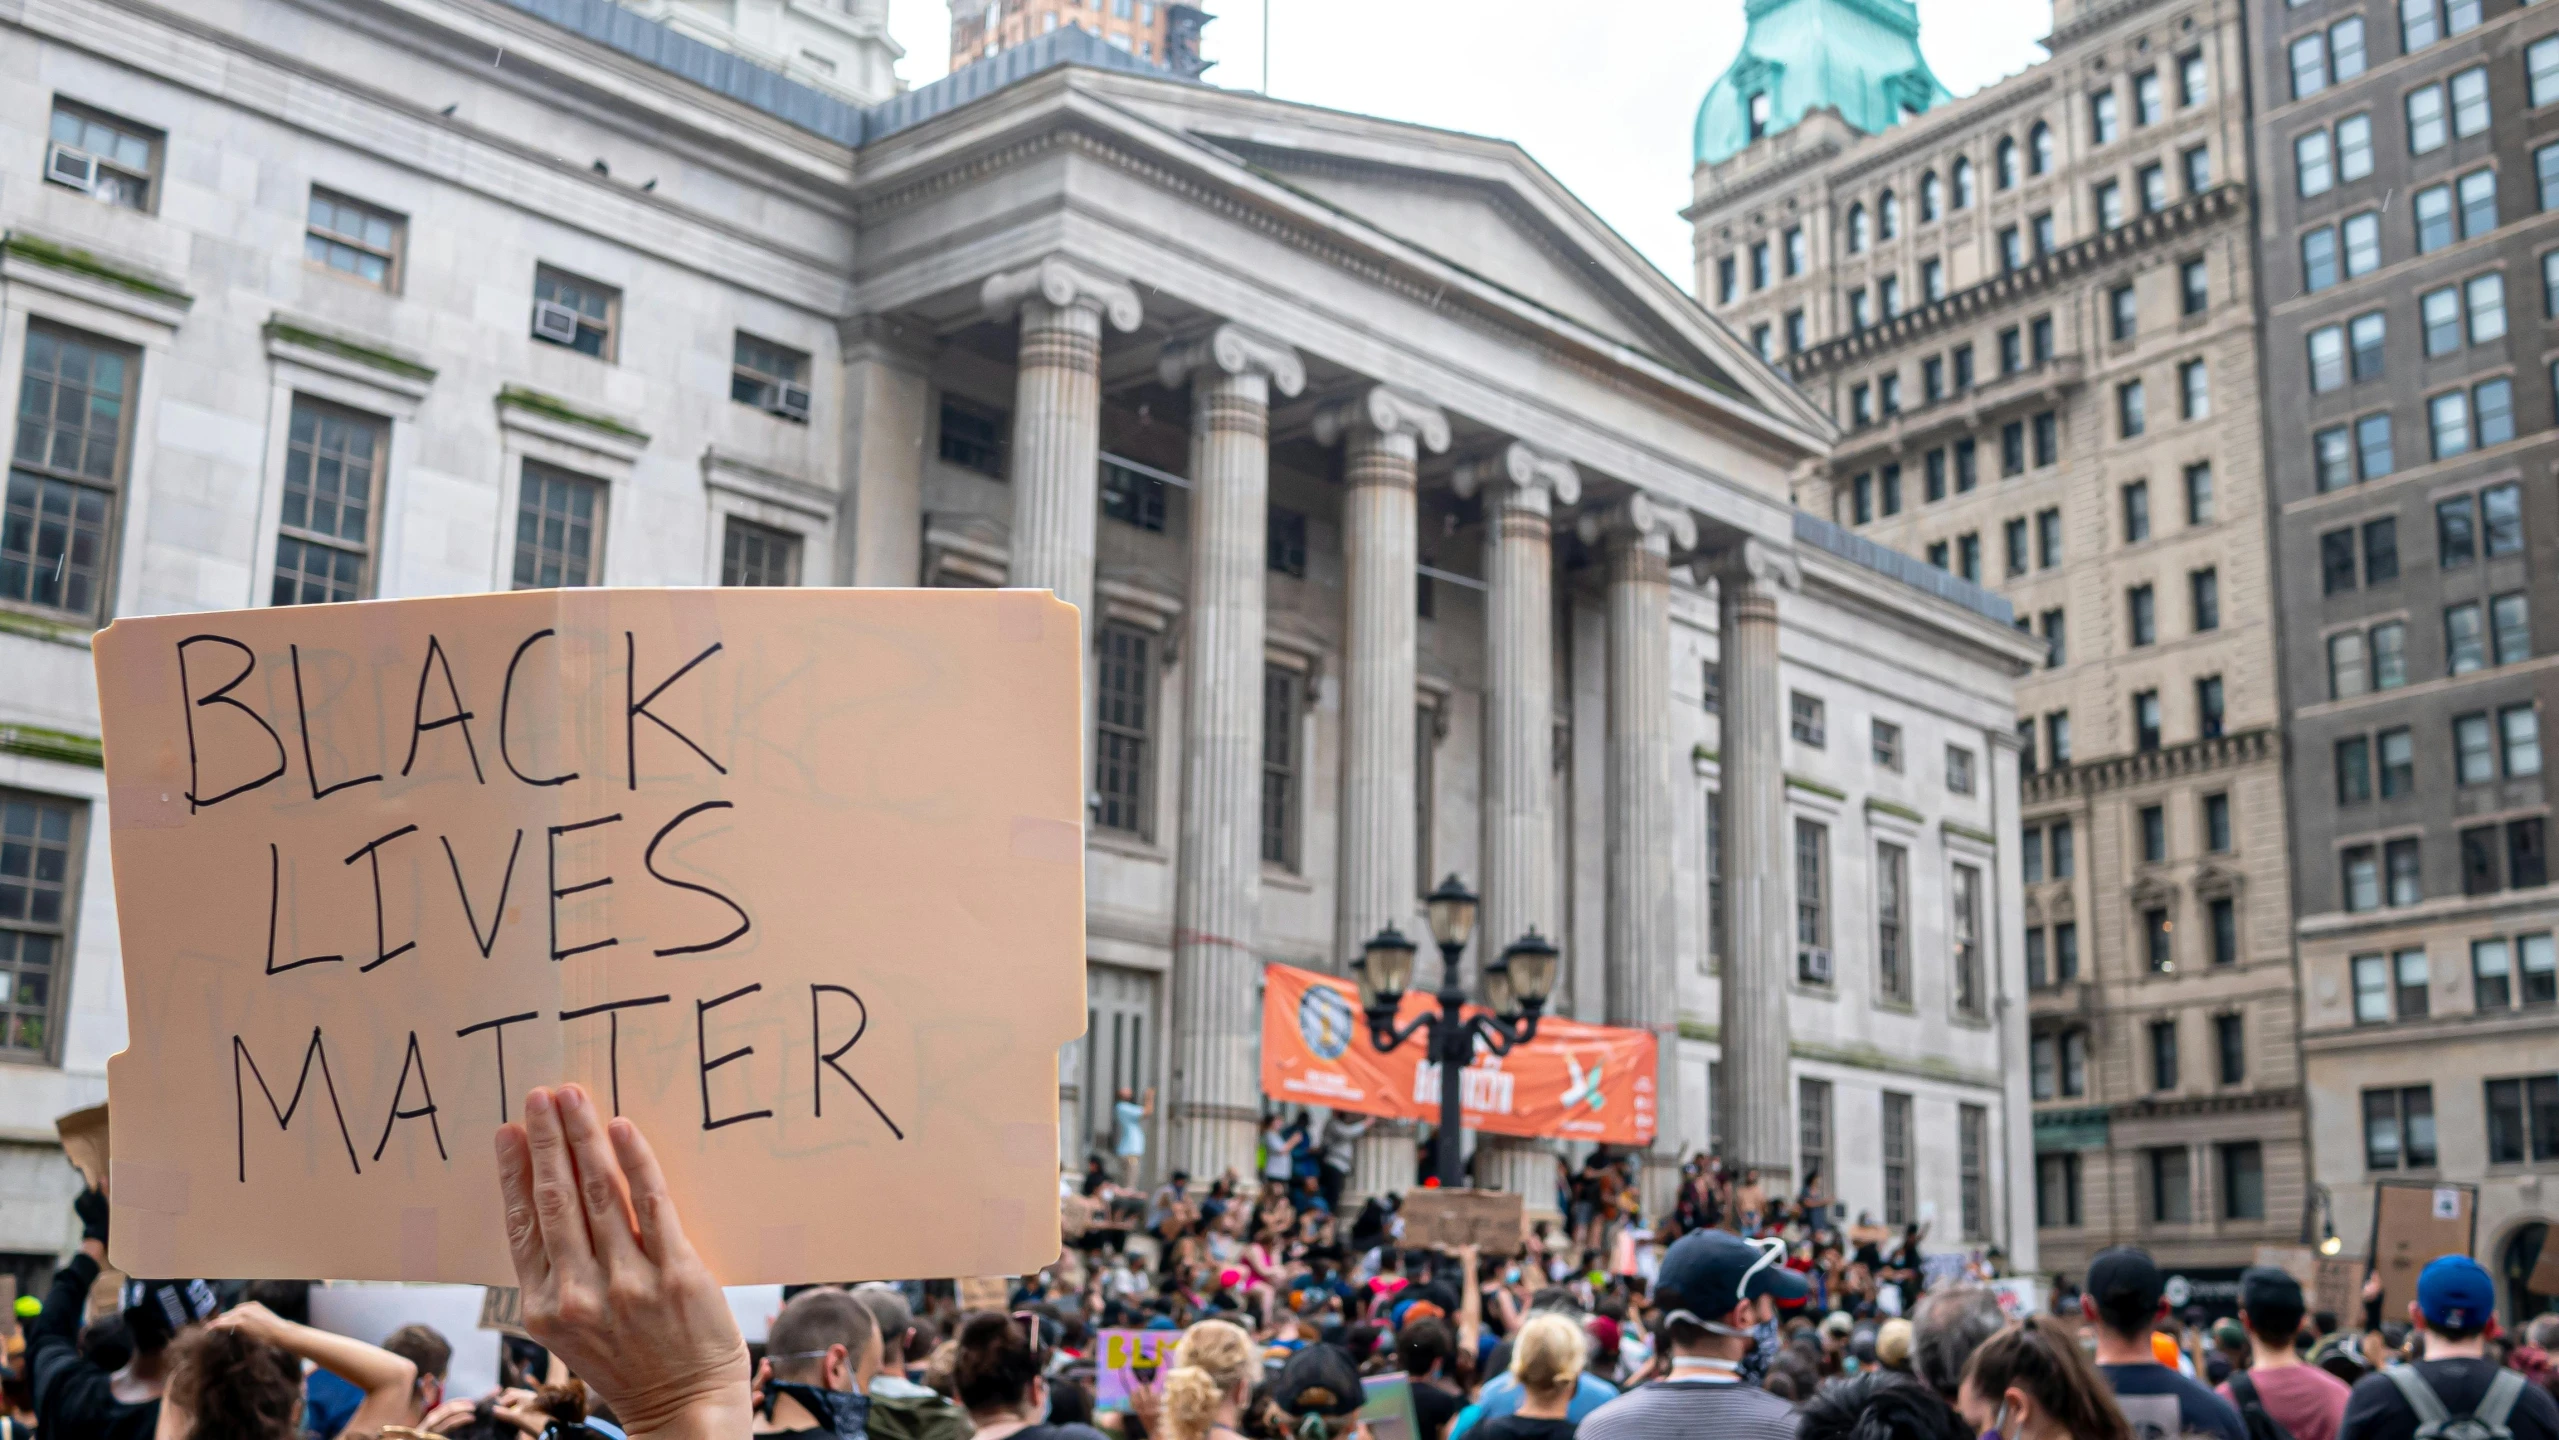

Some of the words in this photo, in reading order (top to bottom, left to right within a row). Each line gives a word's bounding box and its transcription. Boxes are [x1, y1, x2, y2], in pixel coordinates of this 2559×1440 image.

[175, 627, 728, 817] BLACK
[263, 799, 752, 977] LIVES
[231, 981, 906, 1184] MATTER
